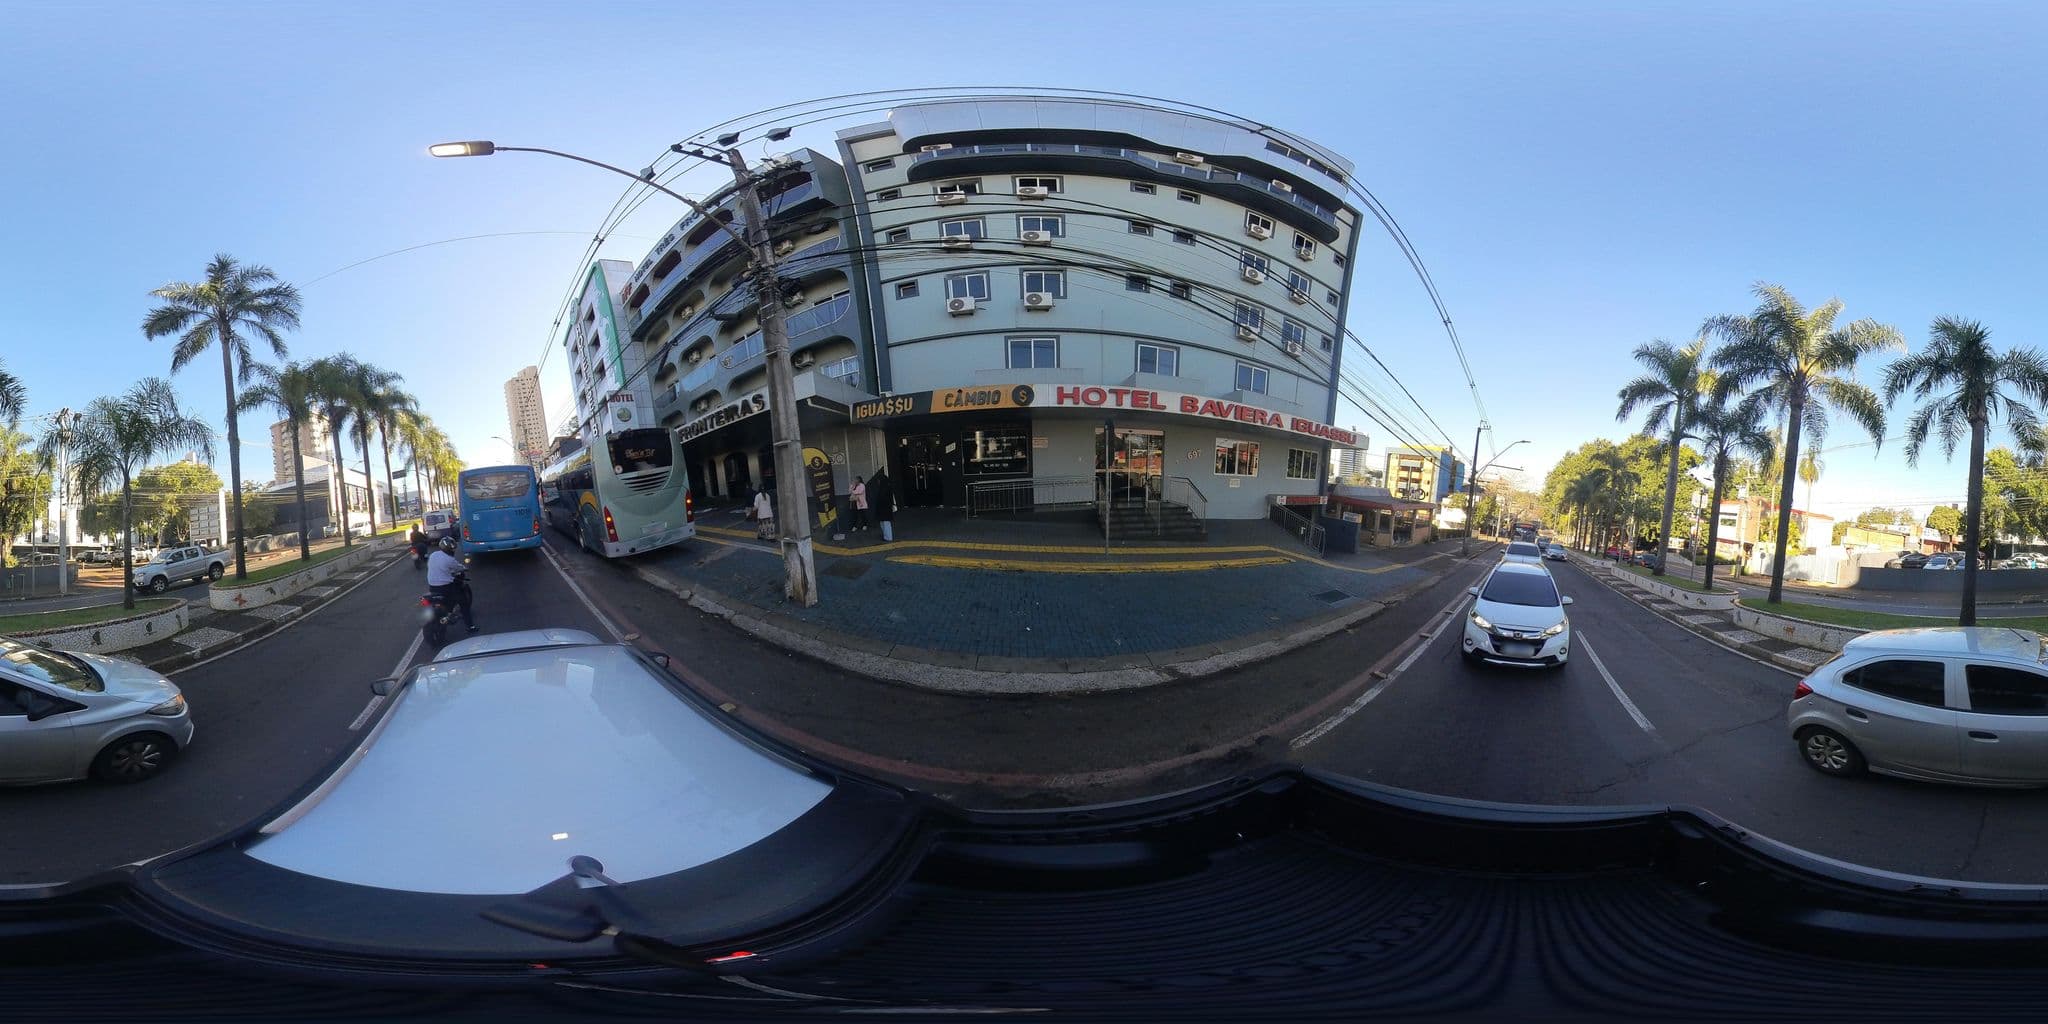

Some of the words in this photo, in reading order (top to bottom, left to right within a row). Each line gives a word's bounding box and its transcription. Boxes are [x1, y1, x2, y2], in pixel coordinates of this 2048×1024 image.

[678, 394, 765, 440] FRONTEIRAS
[944, 389, 1001, 408] CÂMBIO
[1056, 386, 1167, 410] HOTEL
[1180, 396, 1284, 428] BAVIERA
[1291, 417, 1357, 445] IGUASSU
